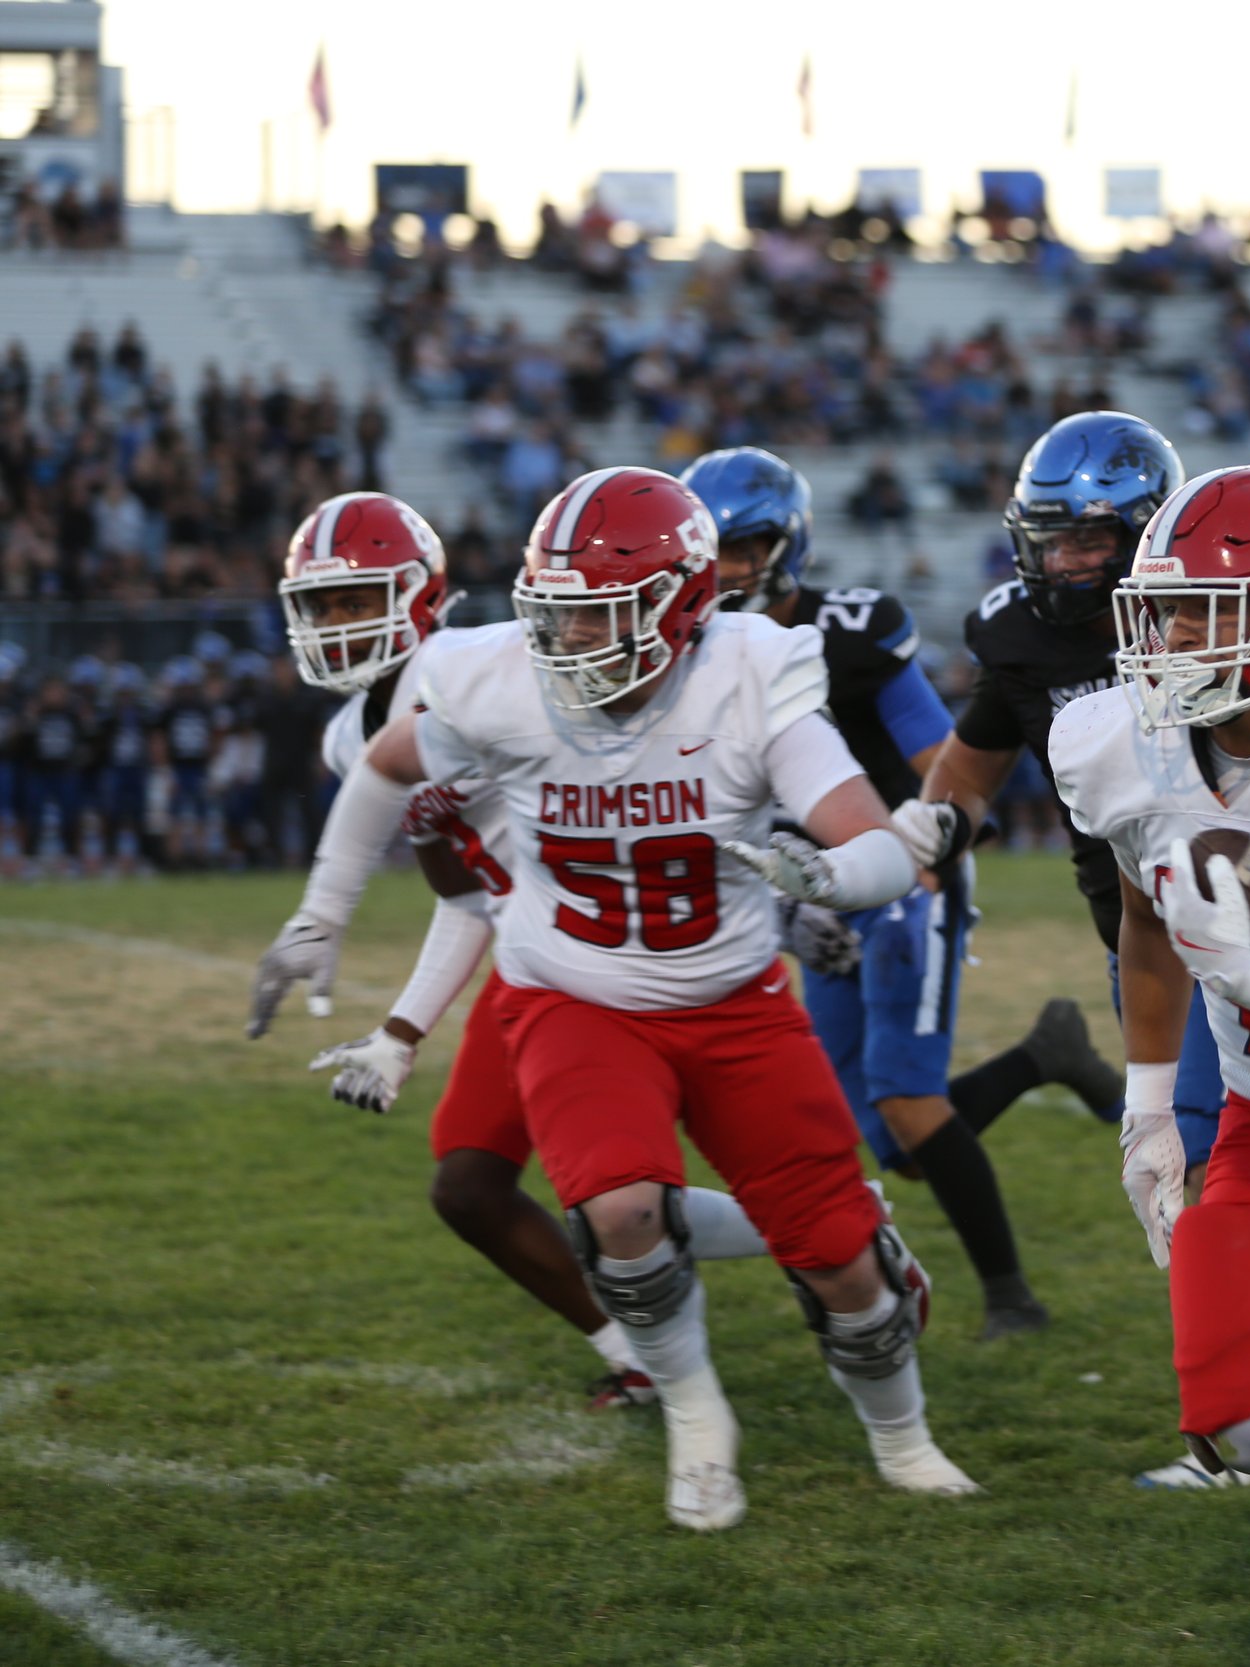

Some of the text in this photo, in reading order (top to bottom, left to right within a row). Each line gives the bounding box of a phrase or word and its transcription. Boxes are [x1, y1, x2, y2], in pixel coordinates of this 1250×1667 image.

[1138, 562, 1174, 573] Riddell
[539, 778, 706, 827] CRIMSON
[535, 829, 721, 952] 58
